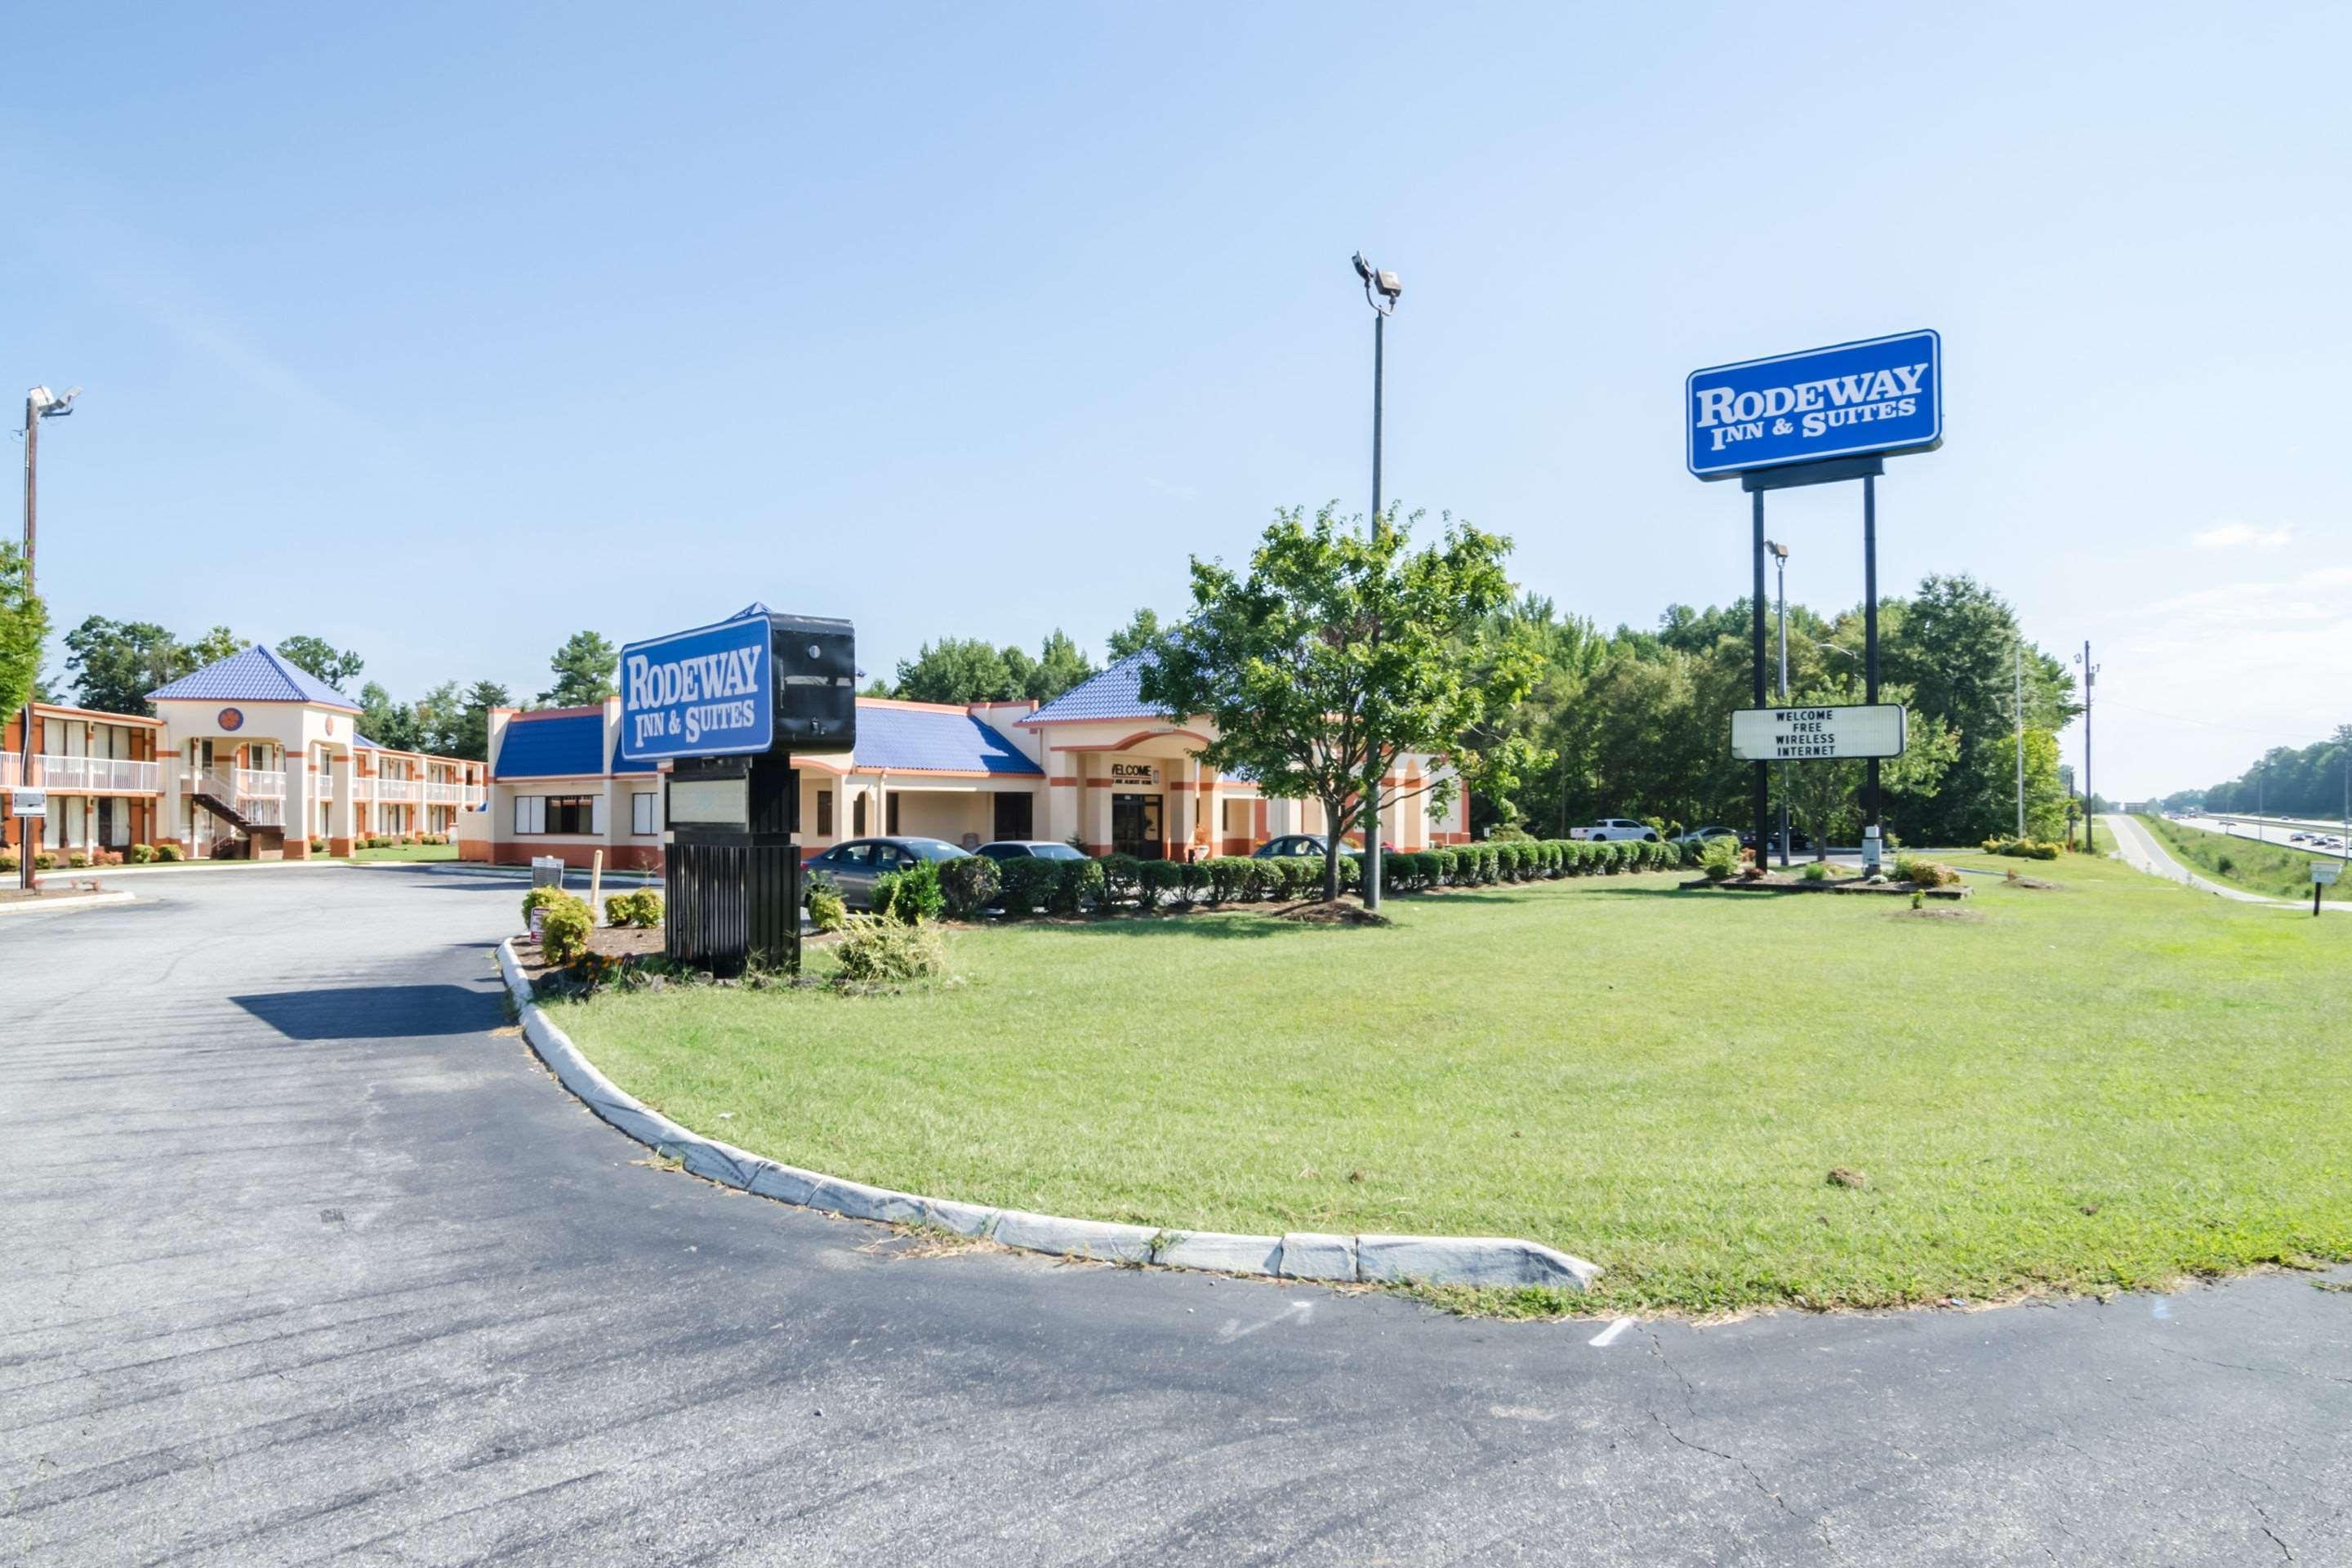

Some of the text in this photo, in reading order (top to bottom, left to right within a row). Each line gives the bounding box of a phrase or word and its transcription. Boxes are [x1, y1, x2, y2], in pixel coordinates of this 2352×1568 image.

[1696, 363, 1929, 428] RODEWAY
[1710, 398, 1917, 451] INN & SUITES
[627, 644, 762, 711] RODEWAY
[635, 699, 755, 748] INN & SUITES
[1775, 710, 1833, 722] WELCOME
[1793, 723, 1822, 733] FREE
[1775, 733, 1835, 745] WIRELESS
[1777, 745, 1836, 757] INTERNET
